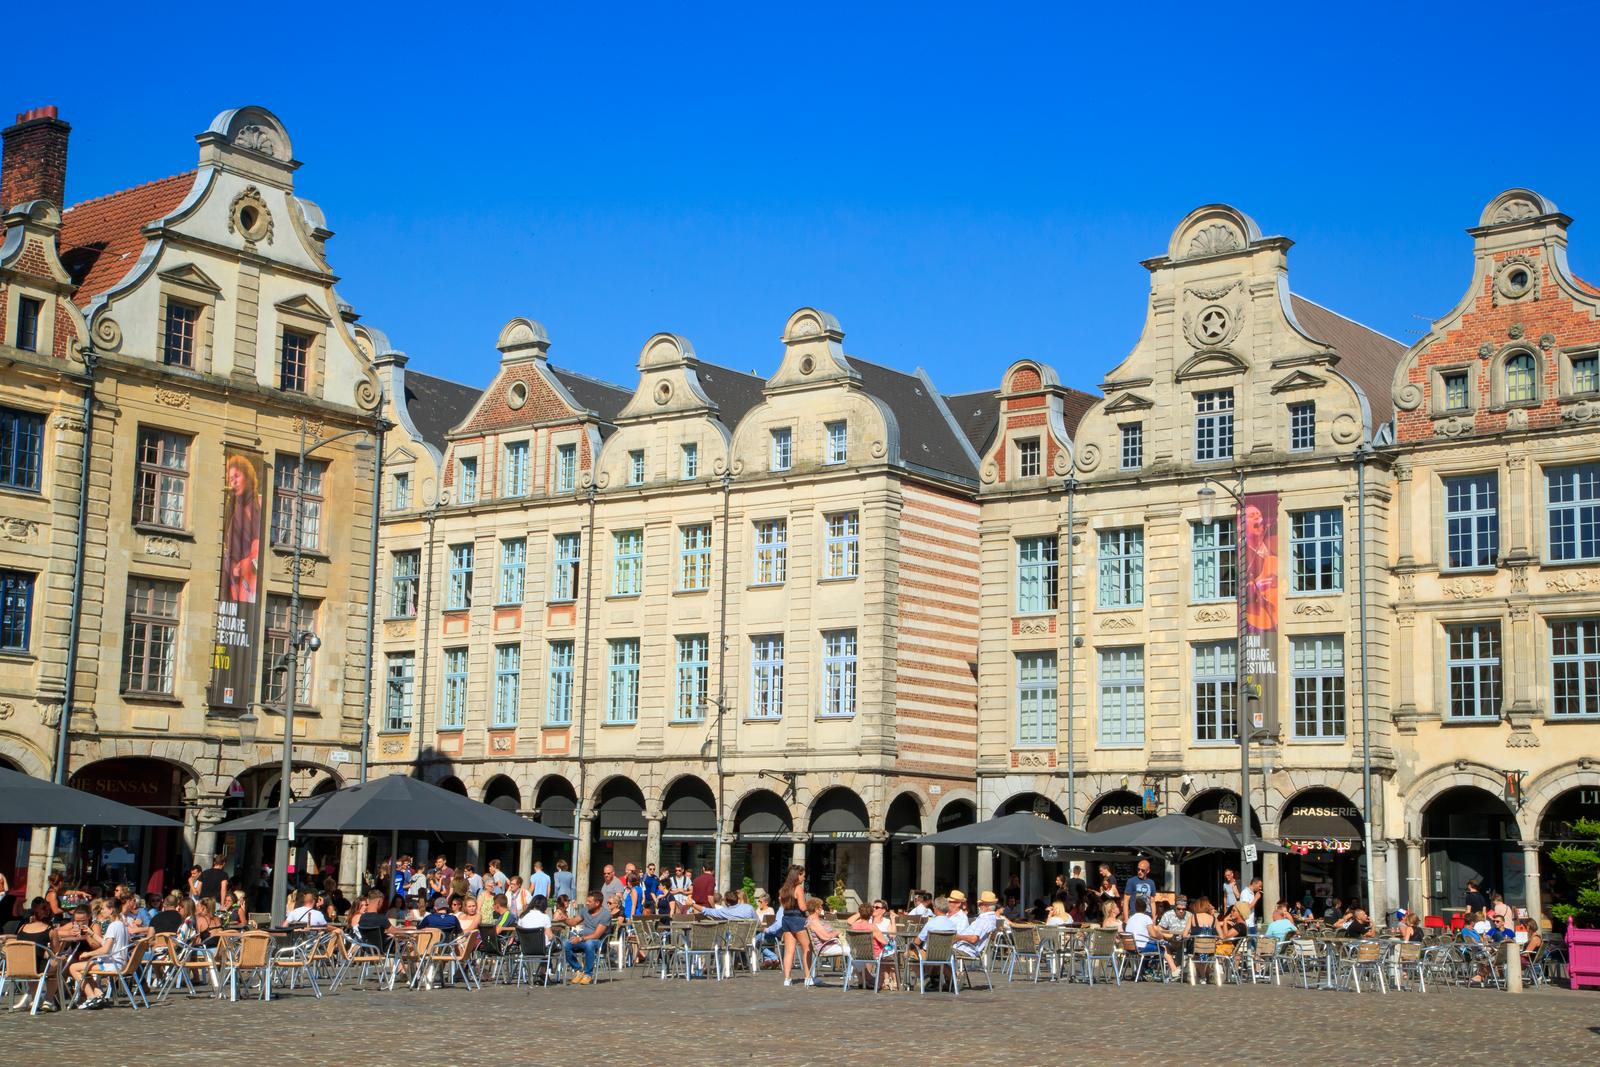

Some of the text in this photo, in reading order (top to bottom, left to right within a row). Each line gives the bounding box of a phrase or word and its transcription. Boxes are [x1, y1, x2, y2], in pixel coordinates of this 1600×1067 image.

[217, 615, 246, 632] SQUARE
[1247, 635, 1261, 648] AIN
[1247, 648, 1270, 661] QUARE
[1247, 661, 1277, 674] ESTIVAL
[95, 778, 159, 793] SENSAS
[1292, 806, 1357, 817] BRASSERIE
[1218, 814, 1237, 825] Leffe
